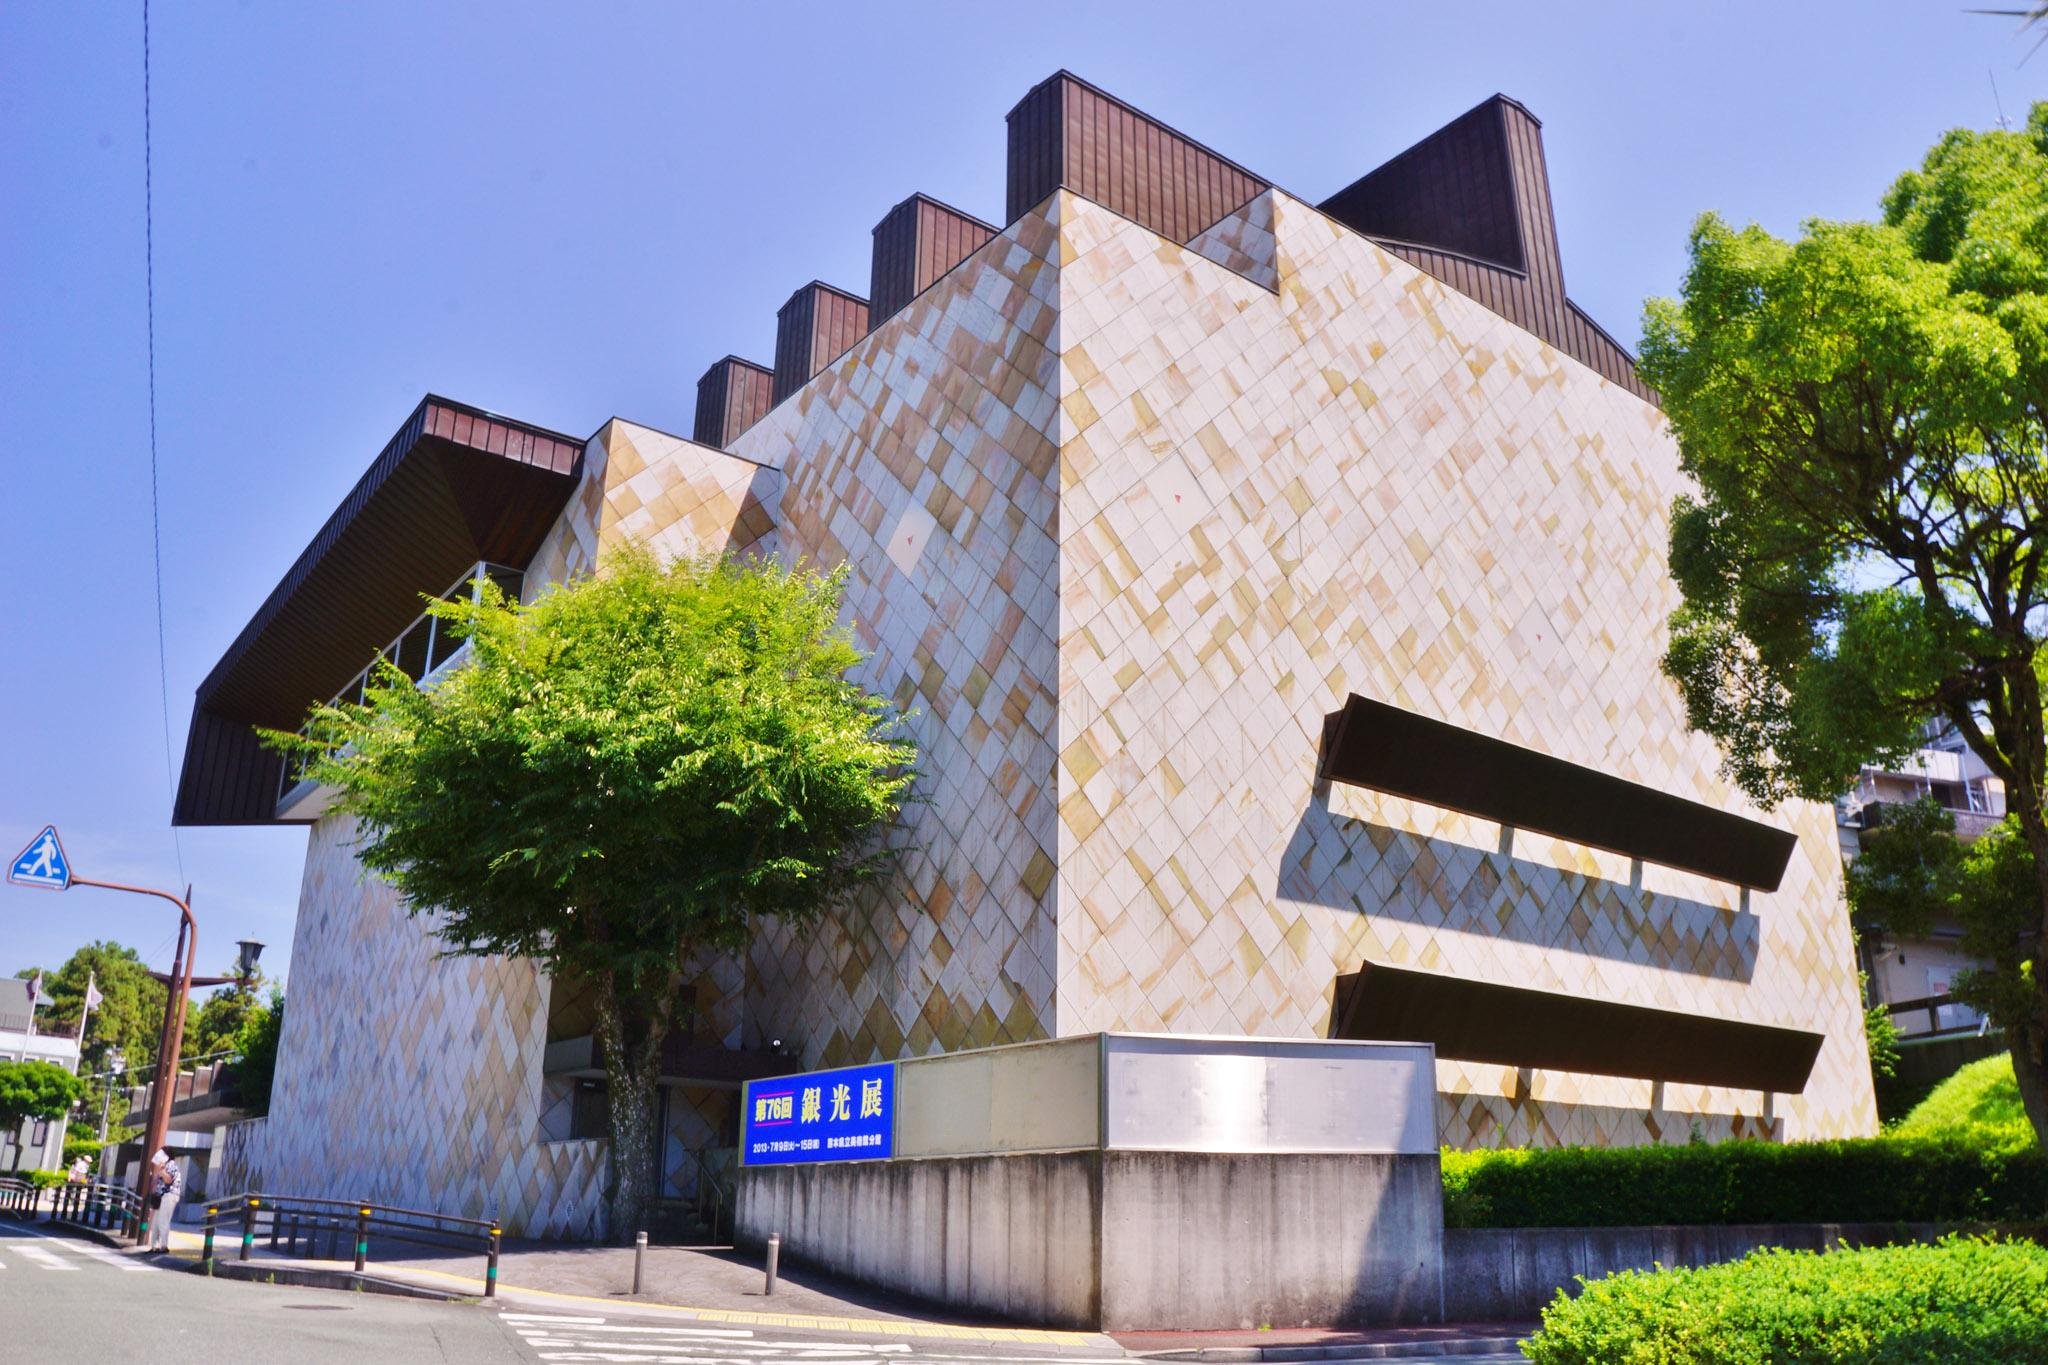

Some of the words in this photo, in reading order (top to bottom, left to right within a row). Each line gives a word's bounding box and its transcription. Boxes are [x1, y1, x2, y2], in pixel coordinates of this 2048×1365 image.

[754, 1096, 793, 1122] 第76回
[801, 1078, 883, 1124] 銀光展
